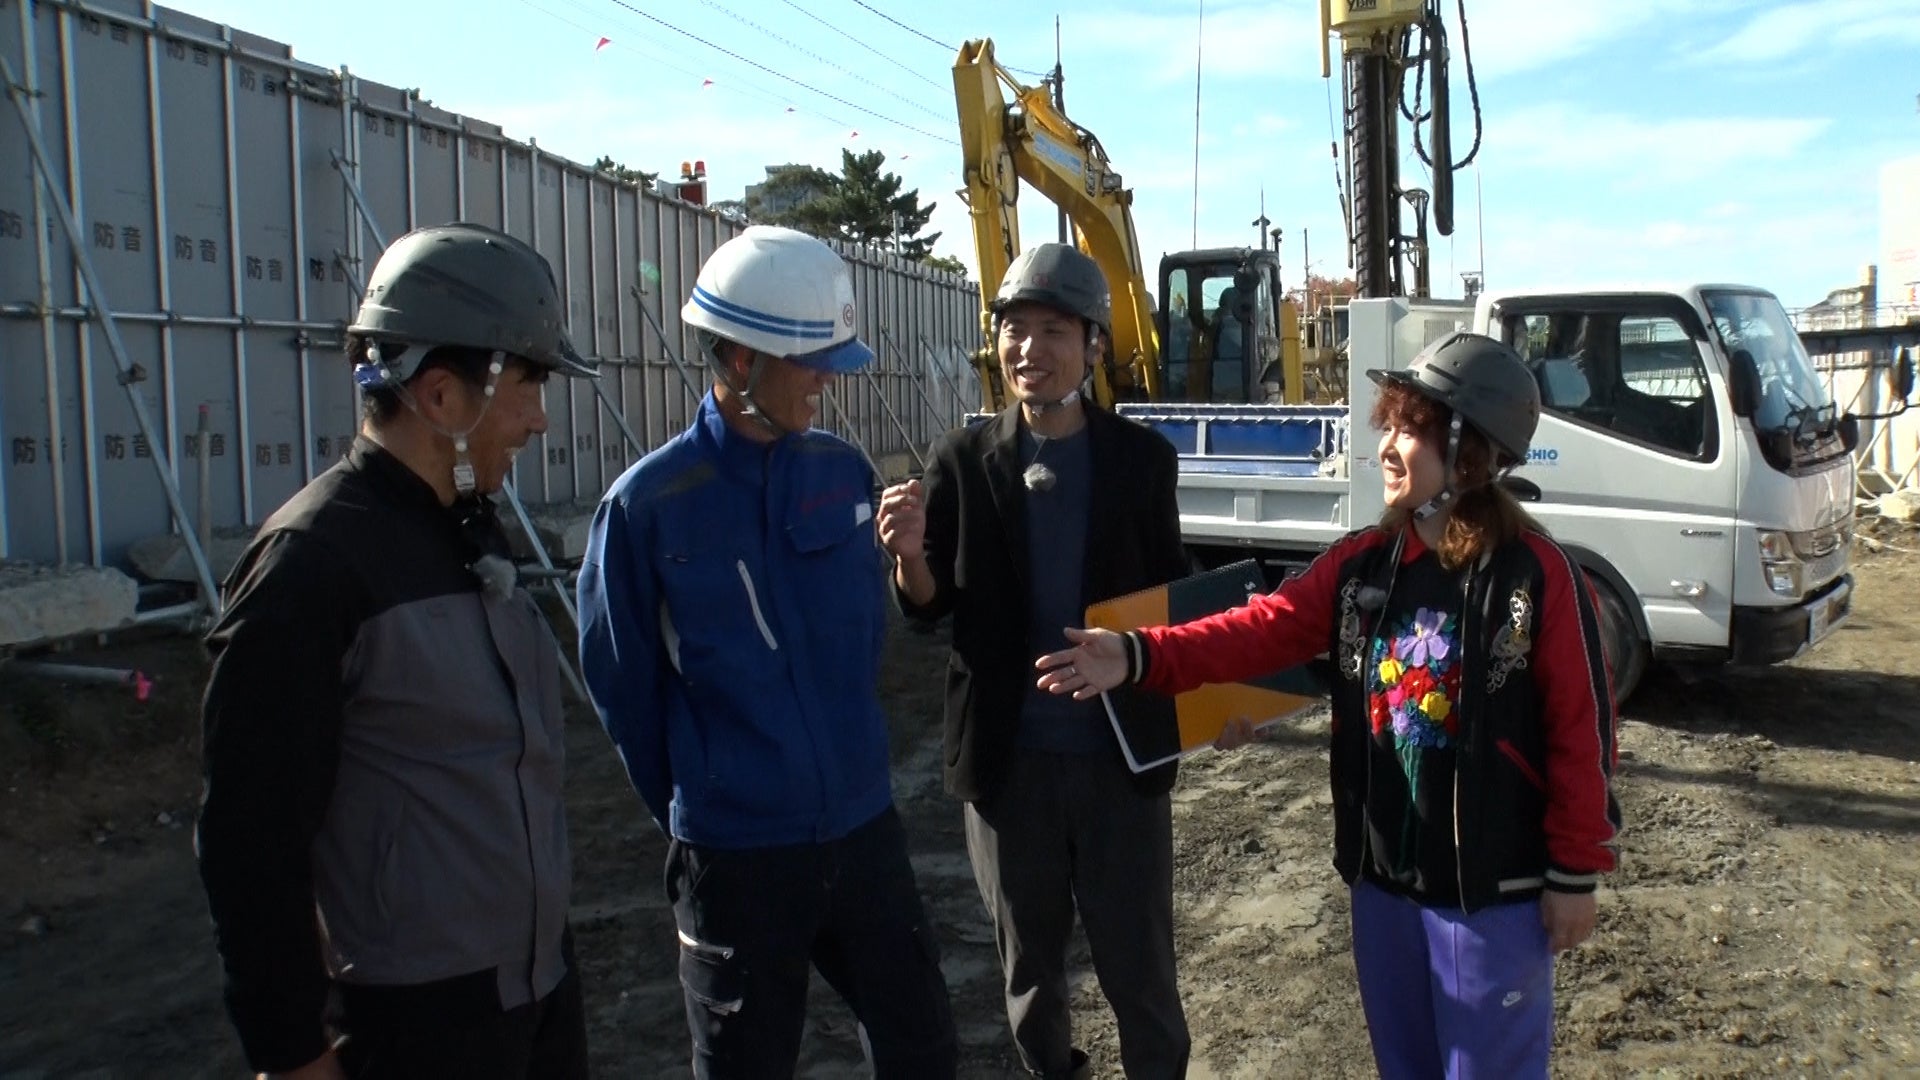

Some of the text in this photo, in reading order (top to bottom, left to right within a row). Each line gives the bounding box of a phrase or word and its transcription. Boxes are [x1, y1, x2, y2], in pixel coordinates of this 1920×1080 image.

[239, 65, 277, 96] 防音
[93, 221, 141, 252] 防音
[174, 234, 217, 264] 防音
[246, 255, 283, 282] 防音
[256, 442, 291, 468] 防音
